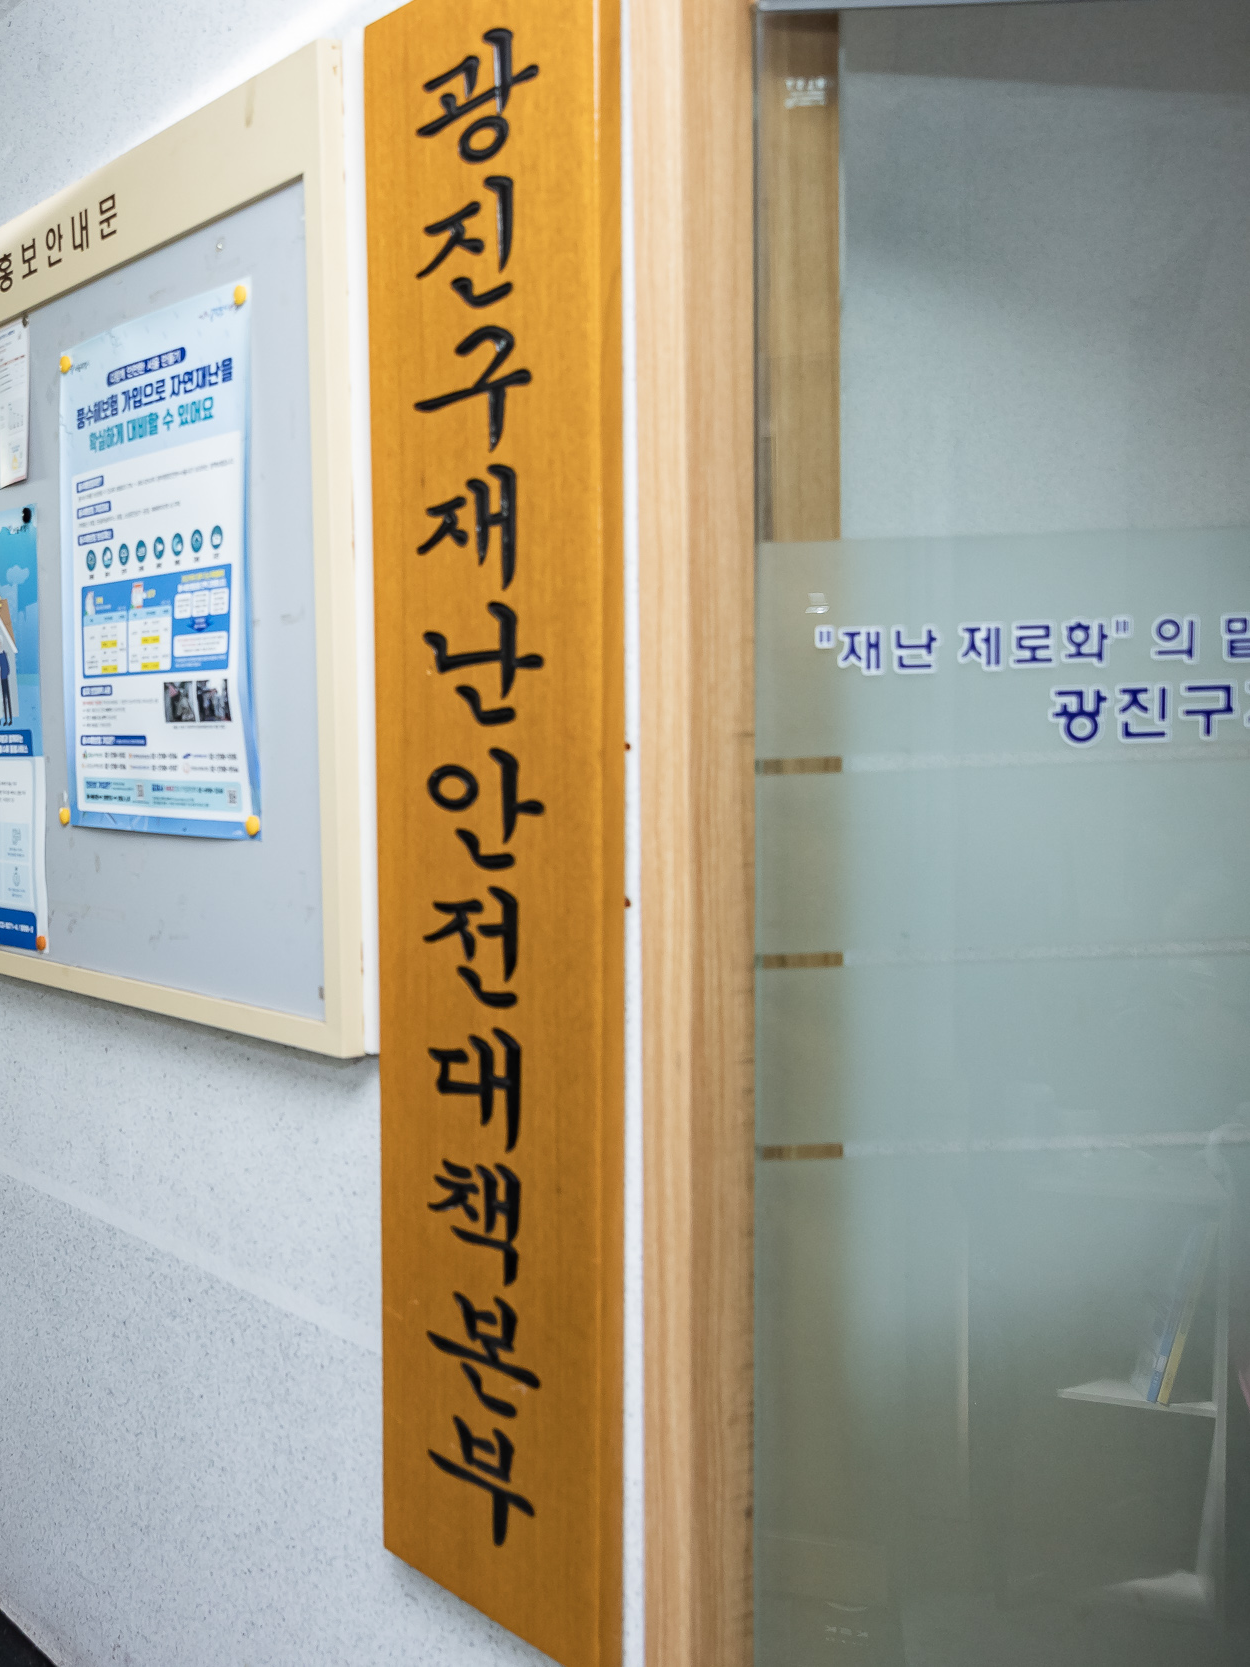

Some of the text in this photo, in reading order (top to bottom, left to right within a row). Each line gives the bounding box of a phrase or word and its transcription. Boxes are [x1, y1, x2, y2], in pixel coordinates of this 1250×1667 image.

[76, 357, 234, 430] 풍수해보험 가입으로 자연재난을
[126, 411, 159, 443] 대비할
[162, 408, 174, 432] 수
[177, 396, 214, 428] 있어요
[1154, 618, 1194, 660] 의
[1052, 683, 1250, 743] 광진구
